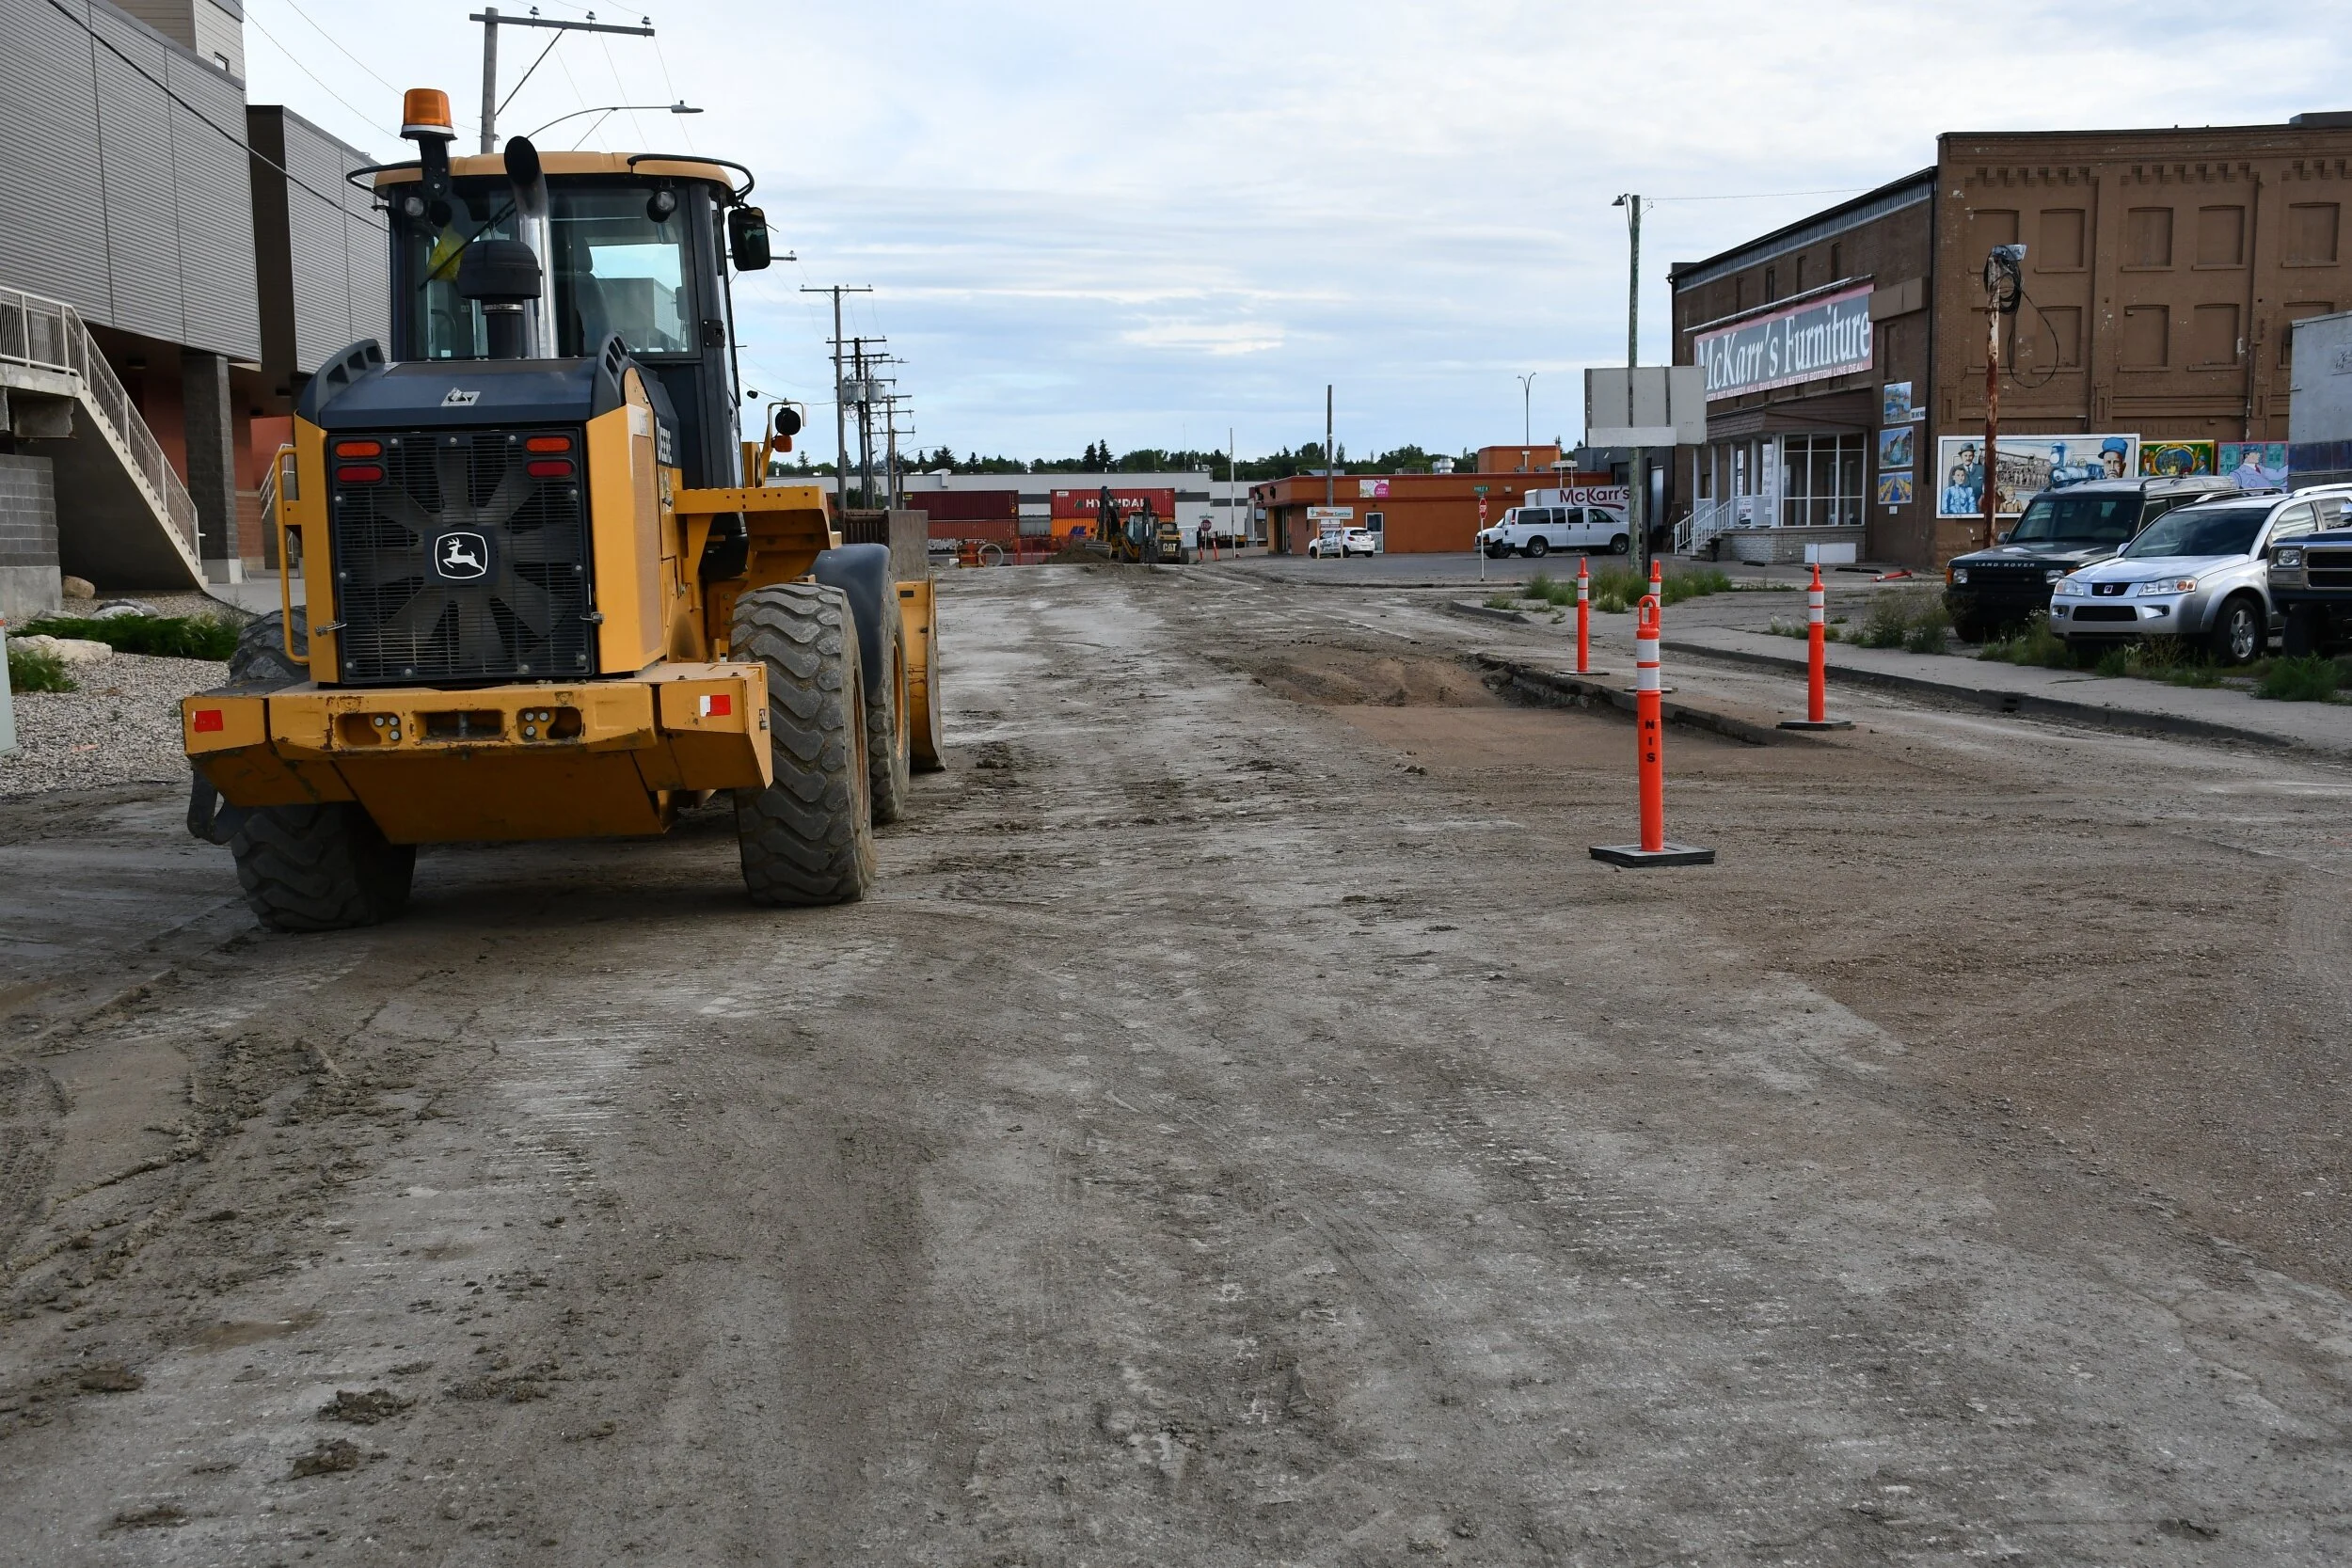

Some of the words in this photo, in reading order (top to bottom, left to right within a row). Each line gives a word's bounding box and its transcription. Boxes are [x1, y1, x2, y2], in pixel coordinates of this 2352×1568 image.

[1698, 323, 1778, 390] McKarr's
[1784, 305, 1870, 373] Furniture
[1759, 381, 1771, 390] GIVE
[1772, 379, 1782, 388] YOU
[1788, 373, 1807, 385] BETTER
[1809, 369, 1832, 380] BOTTOM
[1834, 365, 1846, 376] LINE
[1849, 362, 1865, 373] DEAL
[1560, 486, 1629, 504] McKarr's
[1163, 543, 1177, 552] CAT
